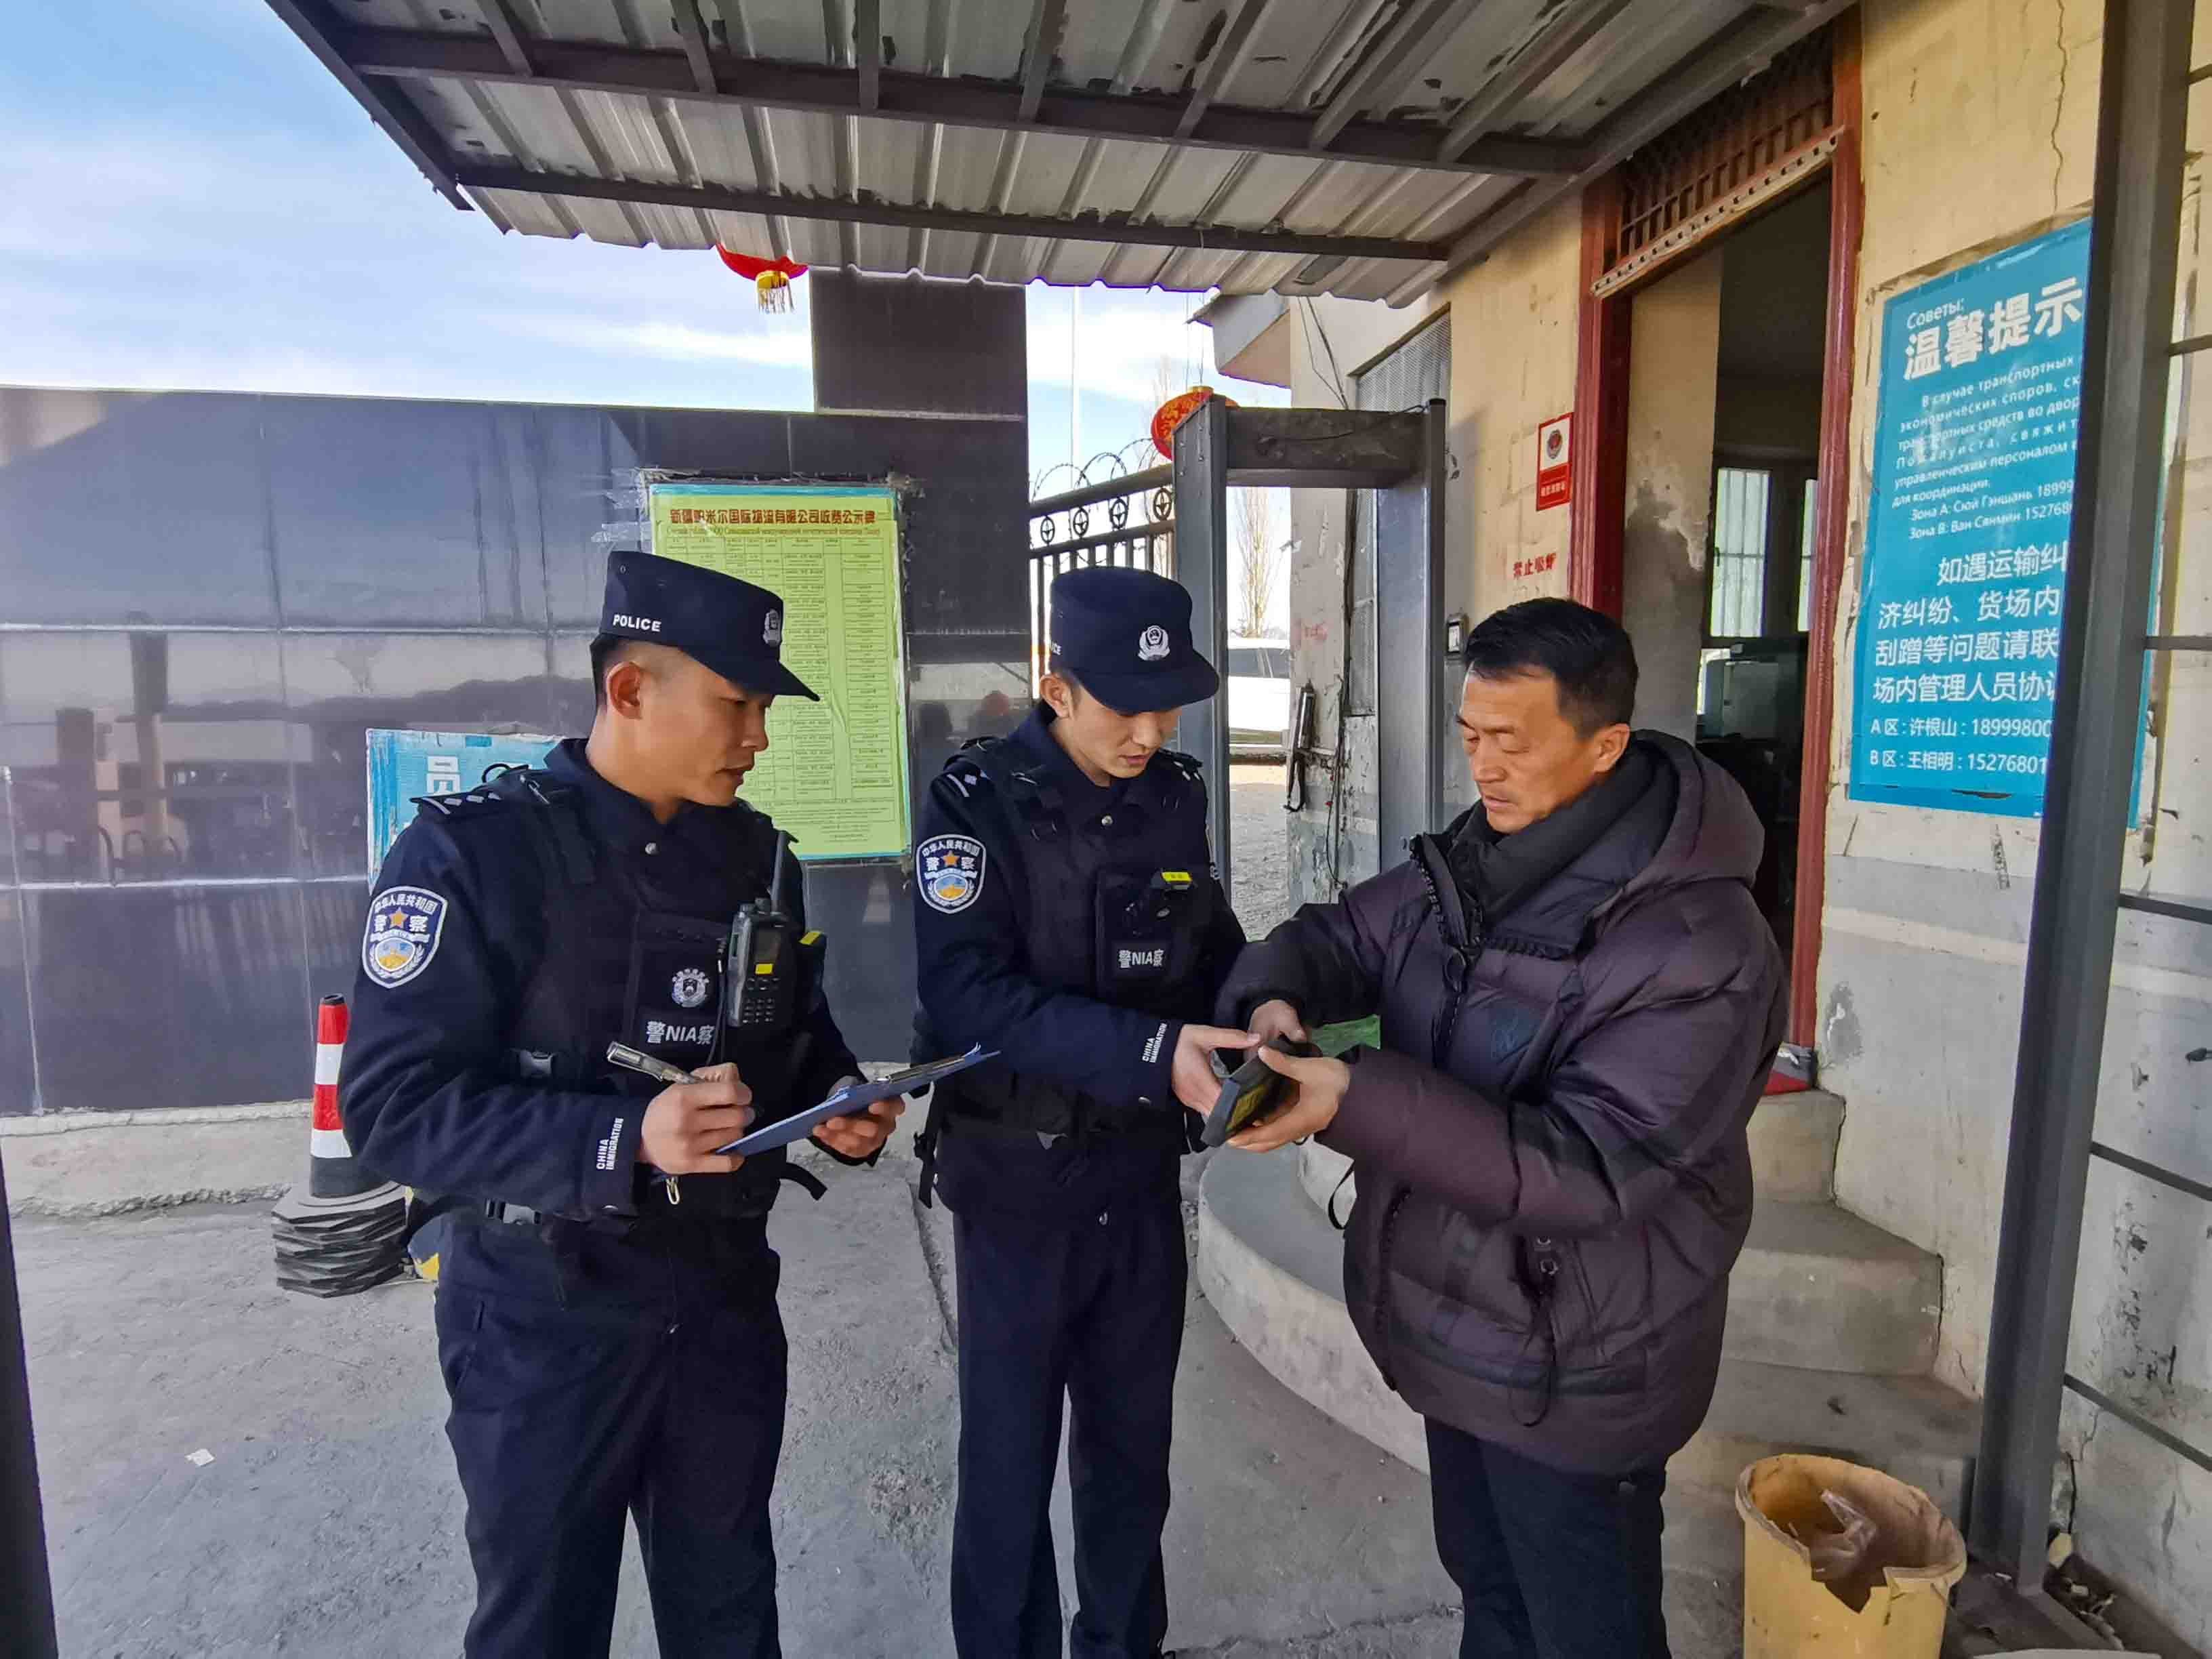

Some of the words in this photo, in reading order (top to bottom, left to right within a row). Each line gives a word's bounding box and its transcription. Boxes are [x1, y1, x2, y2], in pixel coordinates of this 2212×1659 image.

[1904, 276, 2083, 380] 温馨提示
[1906, 298, 1965, 329] Советы:
[1979, 357, 2073, 393] транспортных
[1937, 540, 2068, 586] 如遇运输纠
[613, 614, 661, 632] POLICE
[1878, 584, 2060, 630] 济纠纷、货场内
[1875, 628, 2058, 666] 刮蹭等问题请联
[1142, 1038, 1155, 1061] CHINA
[596, 1139, 609, 1170] CHINA
